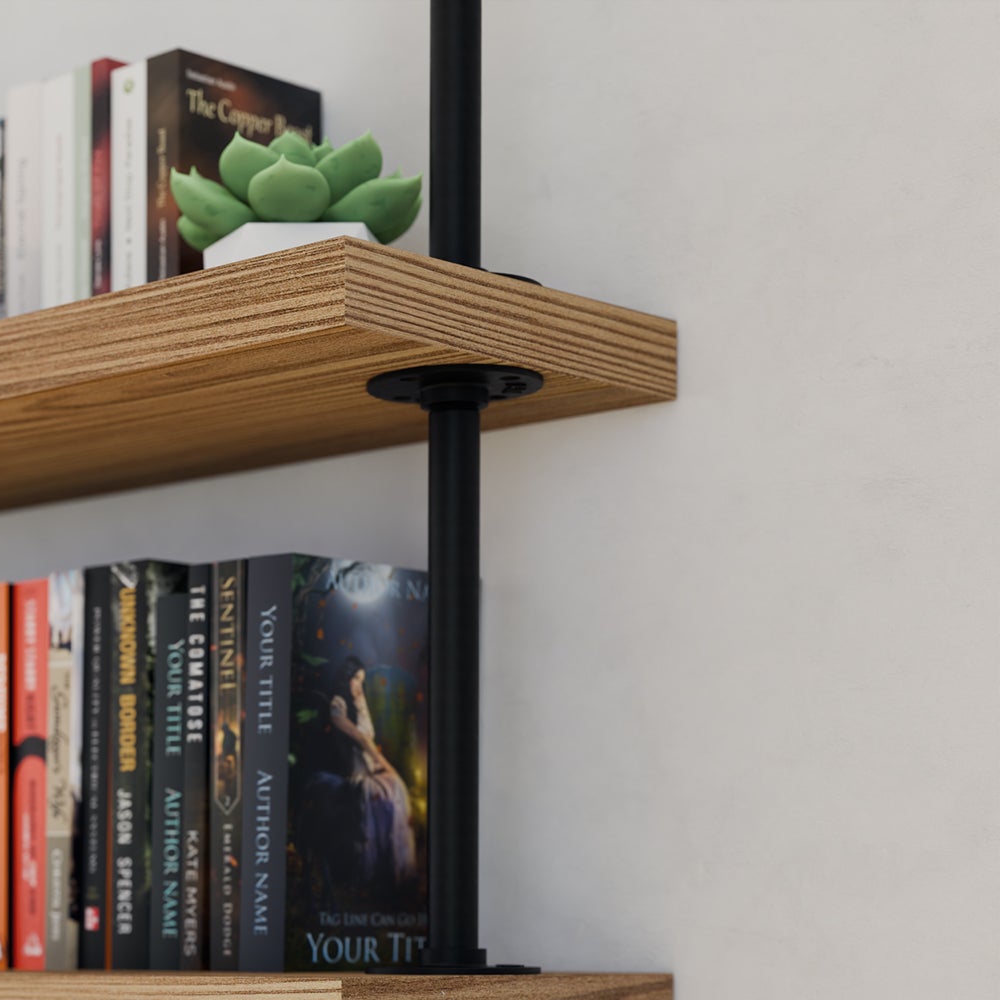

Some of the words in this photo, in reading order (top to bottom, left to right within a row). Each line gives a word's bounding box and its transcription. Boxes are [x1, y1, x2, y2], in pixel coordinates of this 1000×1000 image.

[186, 87, 216, 120] The
[216, 98, 275, 137] Copper
[189, 585, 207, 623] THE
[119, 587, 137, 686] UNKNOWN
[258, 604, 278, 669] YOUR
[166, 639, 186, 699] YOUR
[187, 633, 206, 743] COMATOSE
[119, 694, 137, 773] BORDER
[165, 703, 182, 757] TITLE
[257, 678, 274, 736] TITLE
[116, 787, 134, 846] JASON
[164, 786, 183, 876] AUTHOR
[255, 769, 275, 866] AUTHOR
[184, 830, 199, 883] KATE
[222, 822, 234, 898] EMERALD
[116, 857, 134, 936] SPENCER
[162, 880, 179, 940] NAME
[182, 887, 198, 958] MYERS
[253, 873, 270, 936] NAME
[221, 902, 233, 957] DODGE
[306, 932, 381, 964] YOUR
